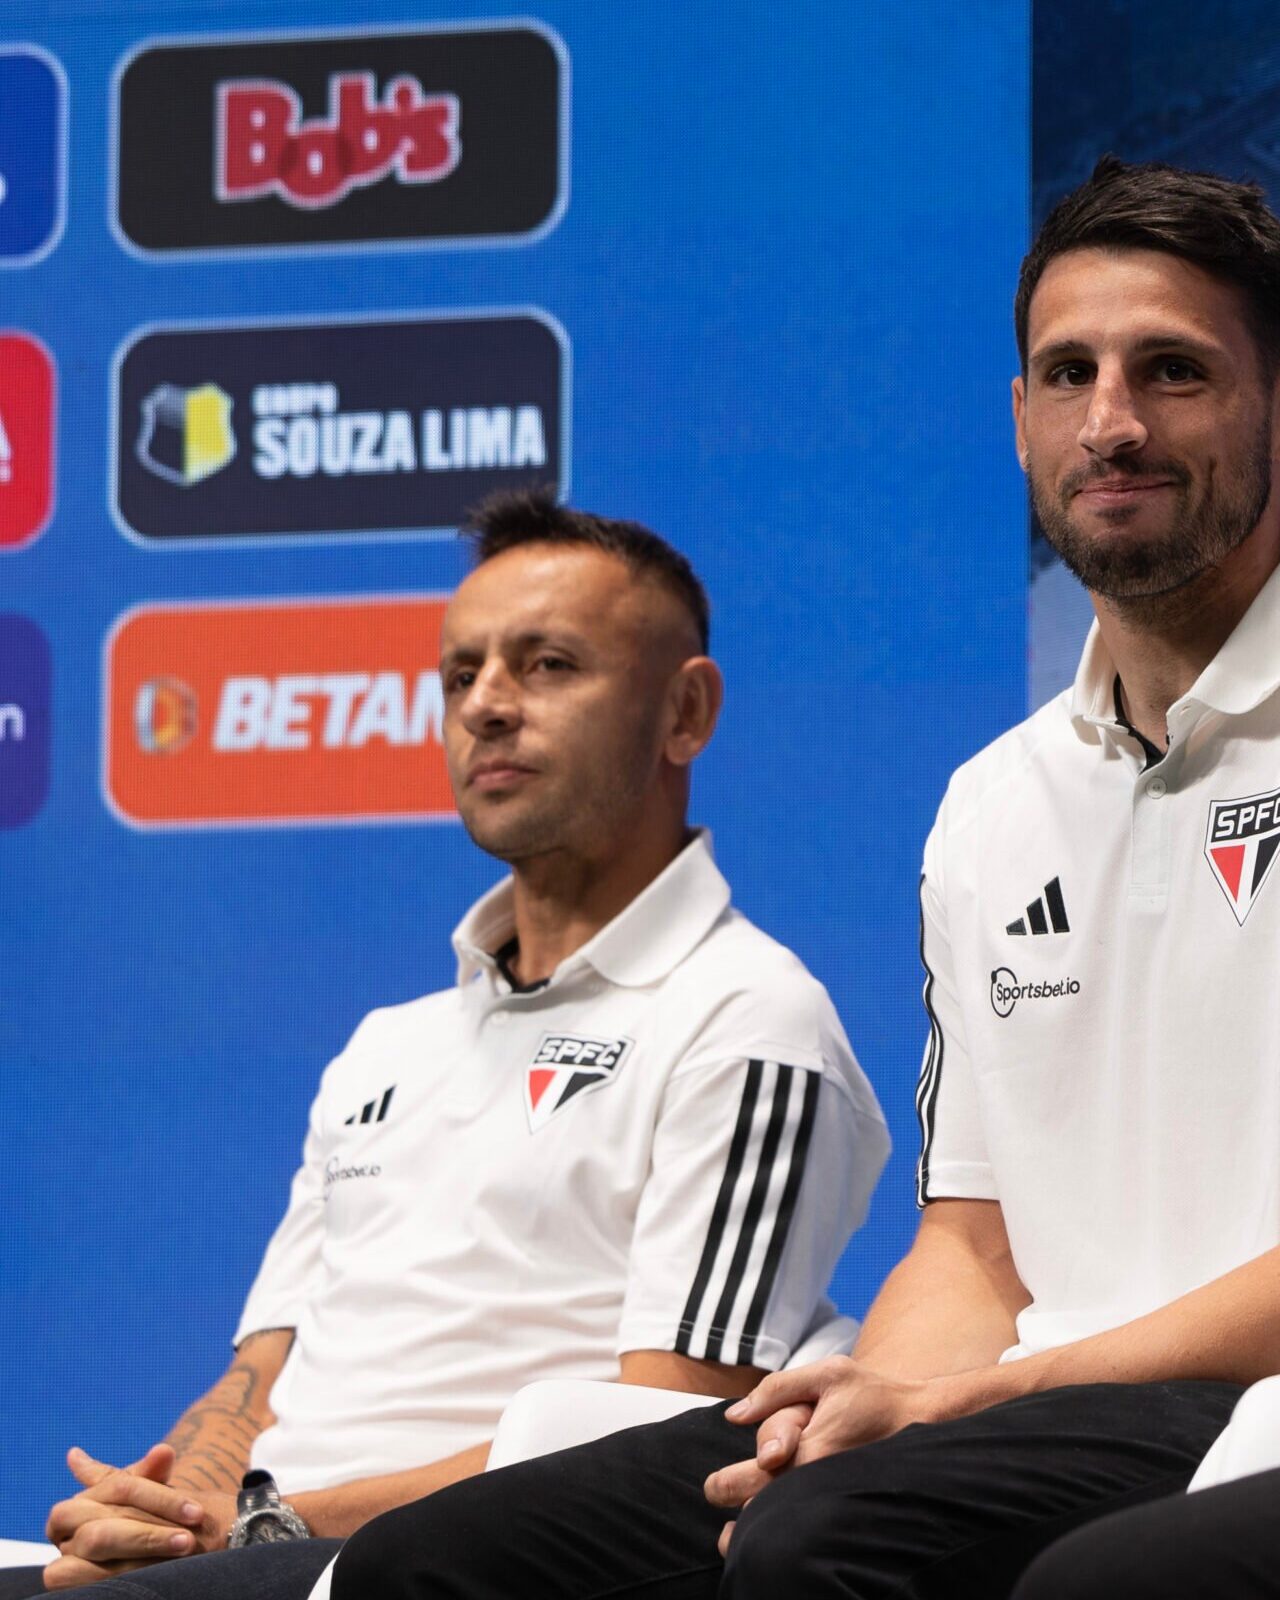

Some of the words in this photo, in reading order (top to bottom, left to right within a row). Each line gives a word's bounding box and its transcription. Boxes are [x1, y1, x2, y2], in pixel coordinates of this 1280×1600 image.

[215, 71, 461, 209] Bob's
[252, 409, 417, 479] SOUZA
[421, 404, 547, 473] LIMA
[995, 975, 1081, 1007] Sportsbet.io
[537, 1038, 622, 1067] SPFC
